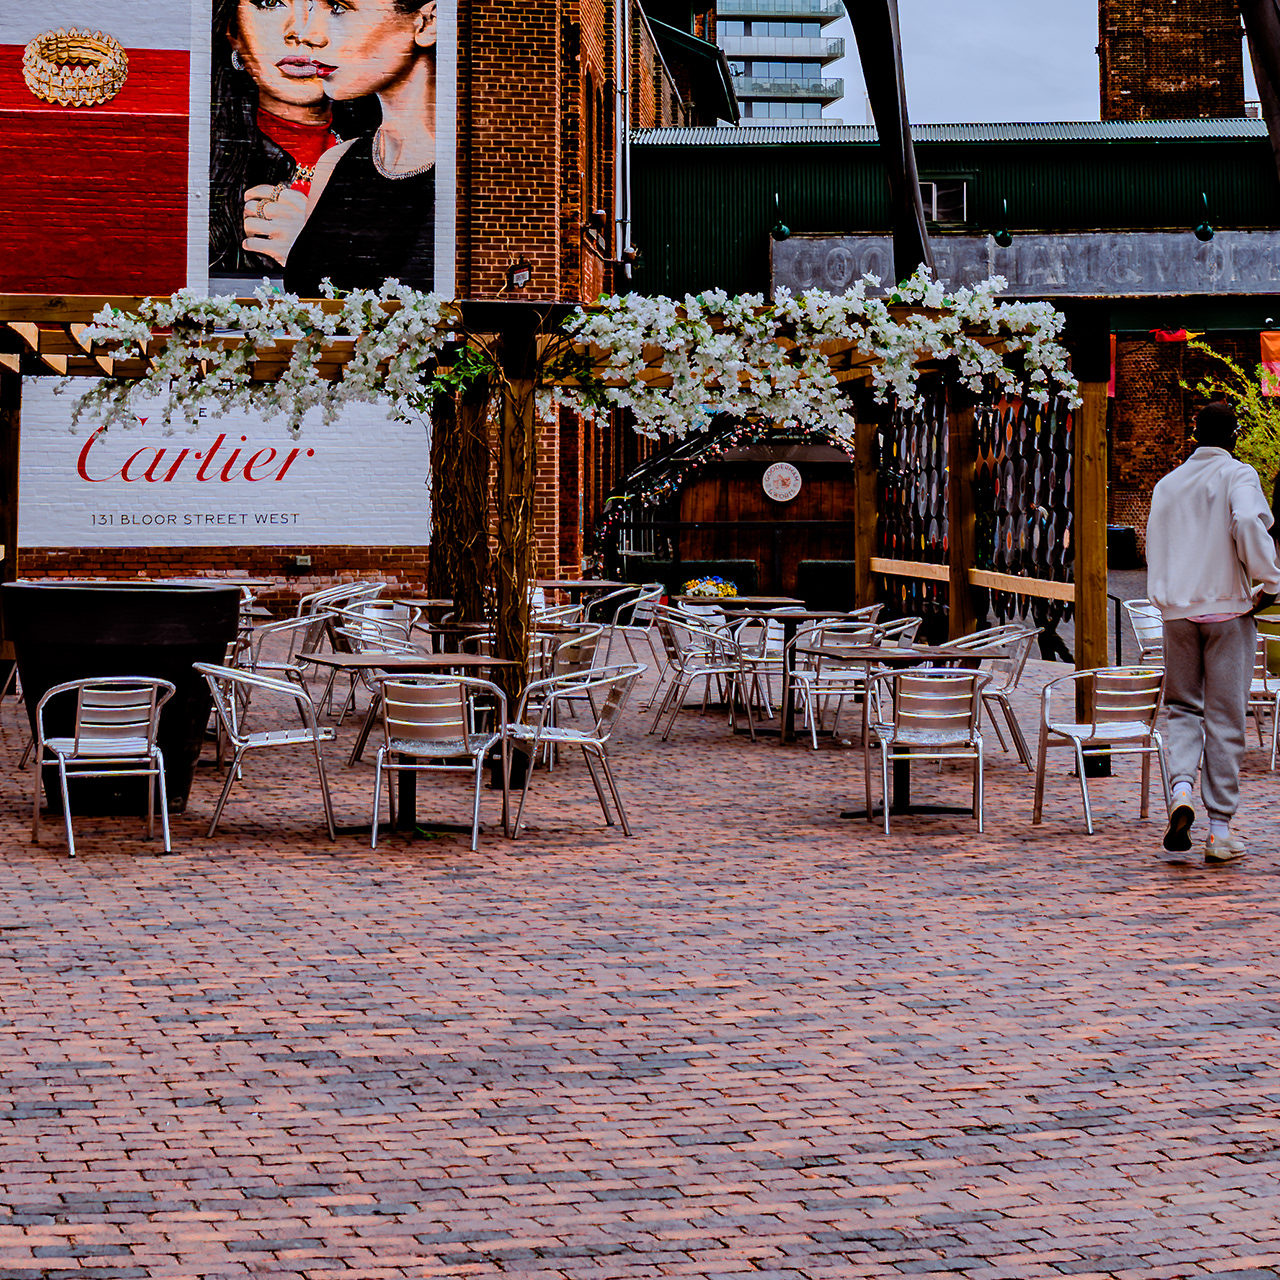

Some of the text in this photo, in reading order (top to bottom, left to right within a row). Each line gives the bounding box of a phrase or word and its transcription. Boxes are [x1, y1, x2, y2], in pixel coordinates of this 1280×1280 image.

[77, 415, 315, 483] Cartier
[765, 464, 799, 482] GOODERHAM
[92, 513, 300, 526] 131 BLOOR STREET WEST
